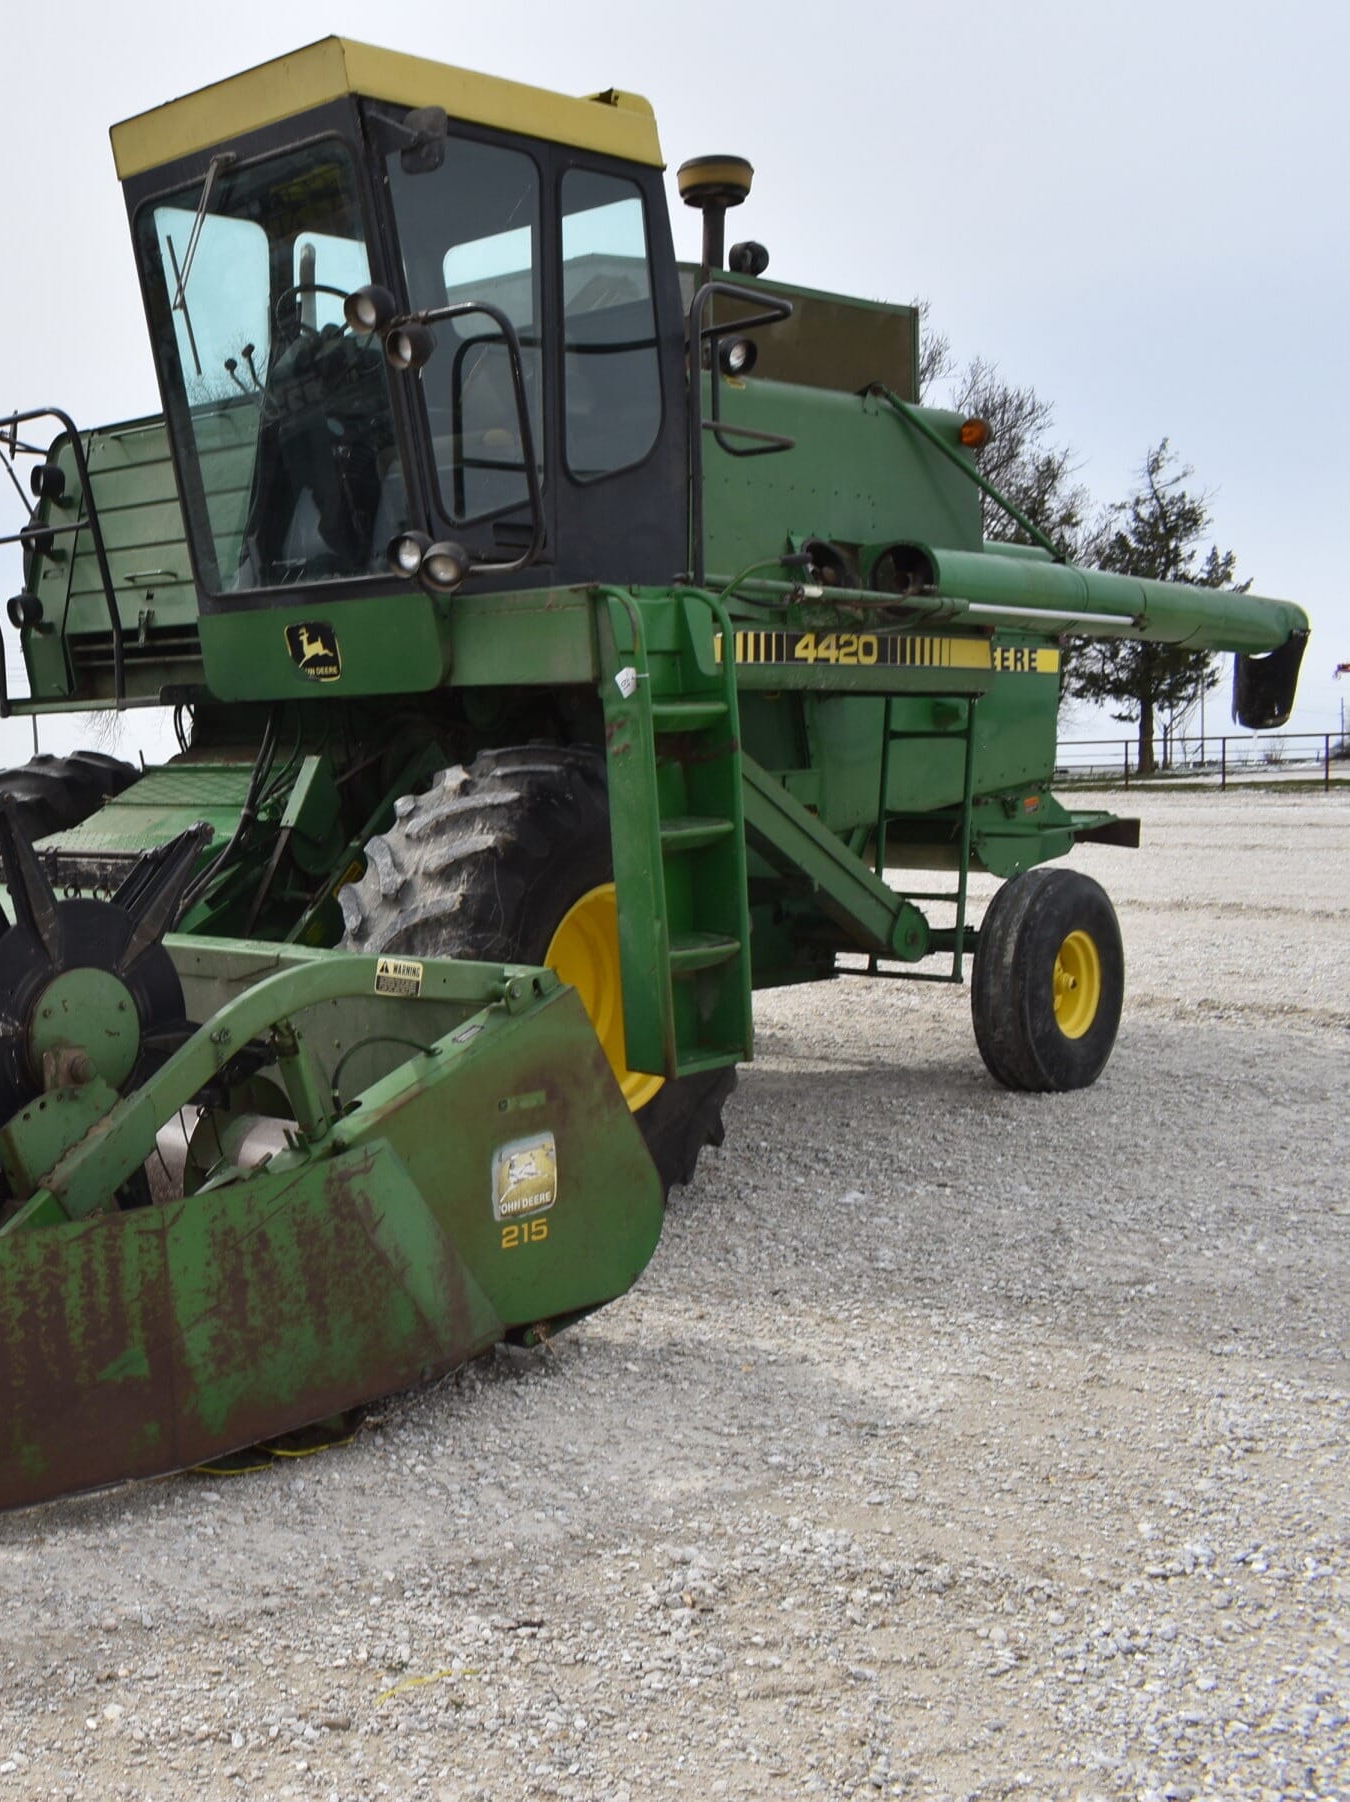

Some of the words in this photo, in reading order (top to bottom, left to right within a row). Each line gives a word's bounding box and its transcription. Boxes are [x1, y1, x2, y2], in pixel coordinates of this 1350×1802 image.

[795, 633, 878, 666] 4420
[393, 963, 421, 978] WARNING
[523, 1190, 552, 1209] DEERE
[502, 1217, 549, 1249] 215
